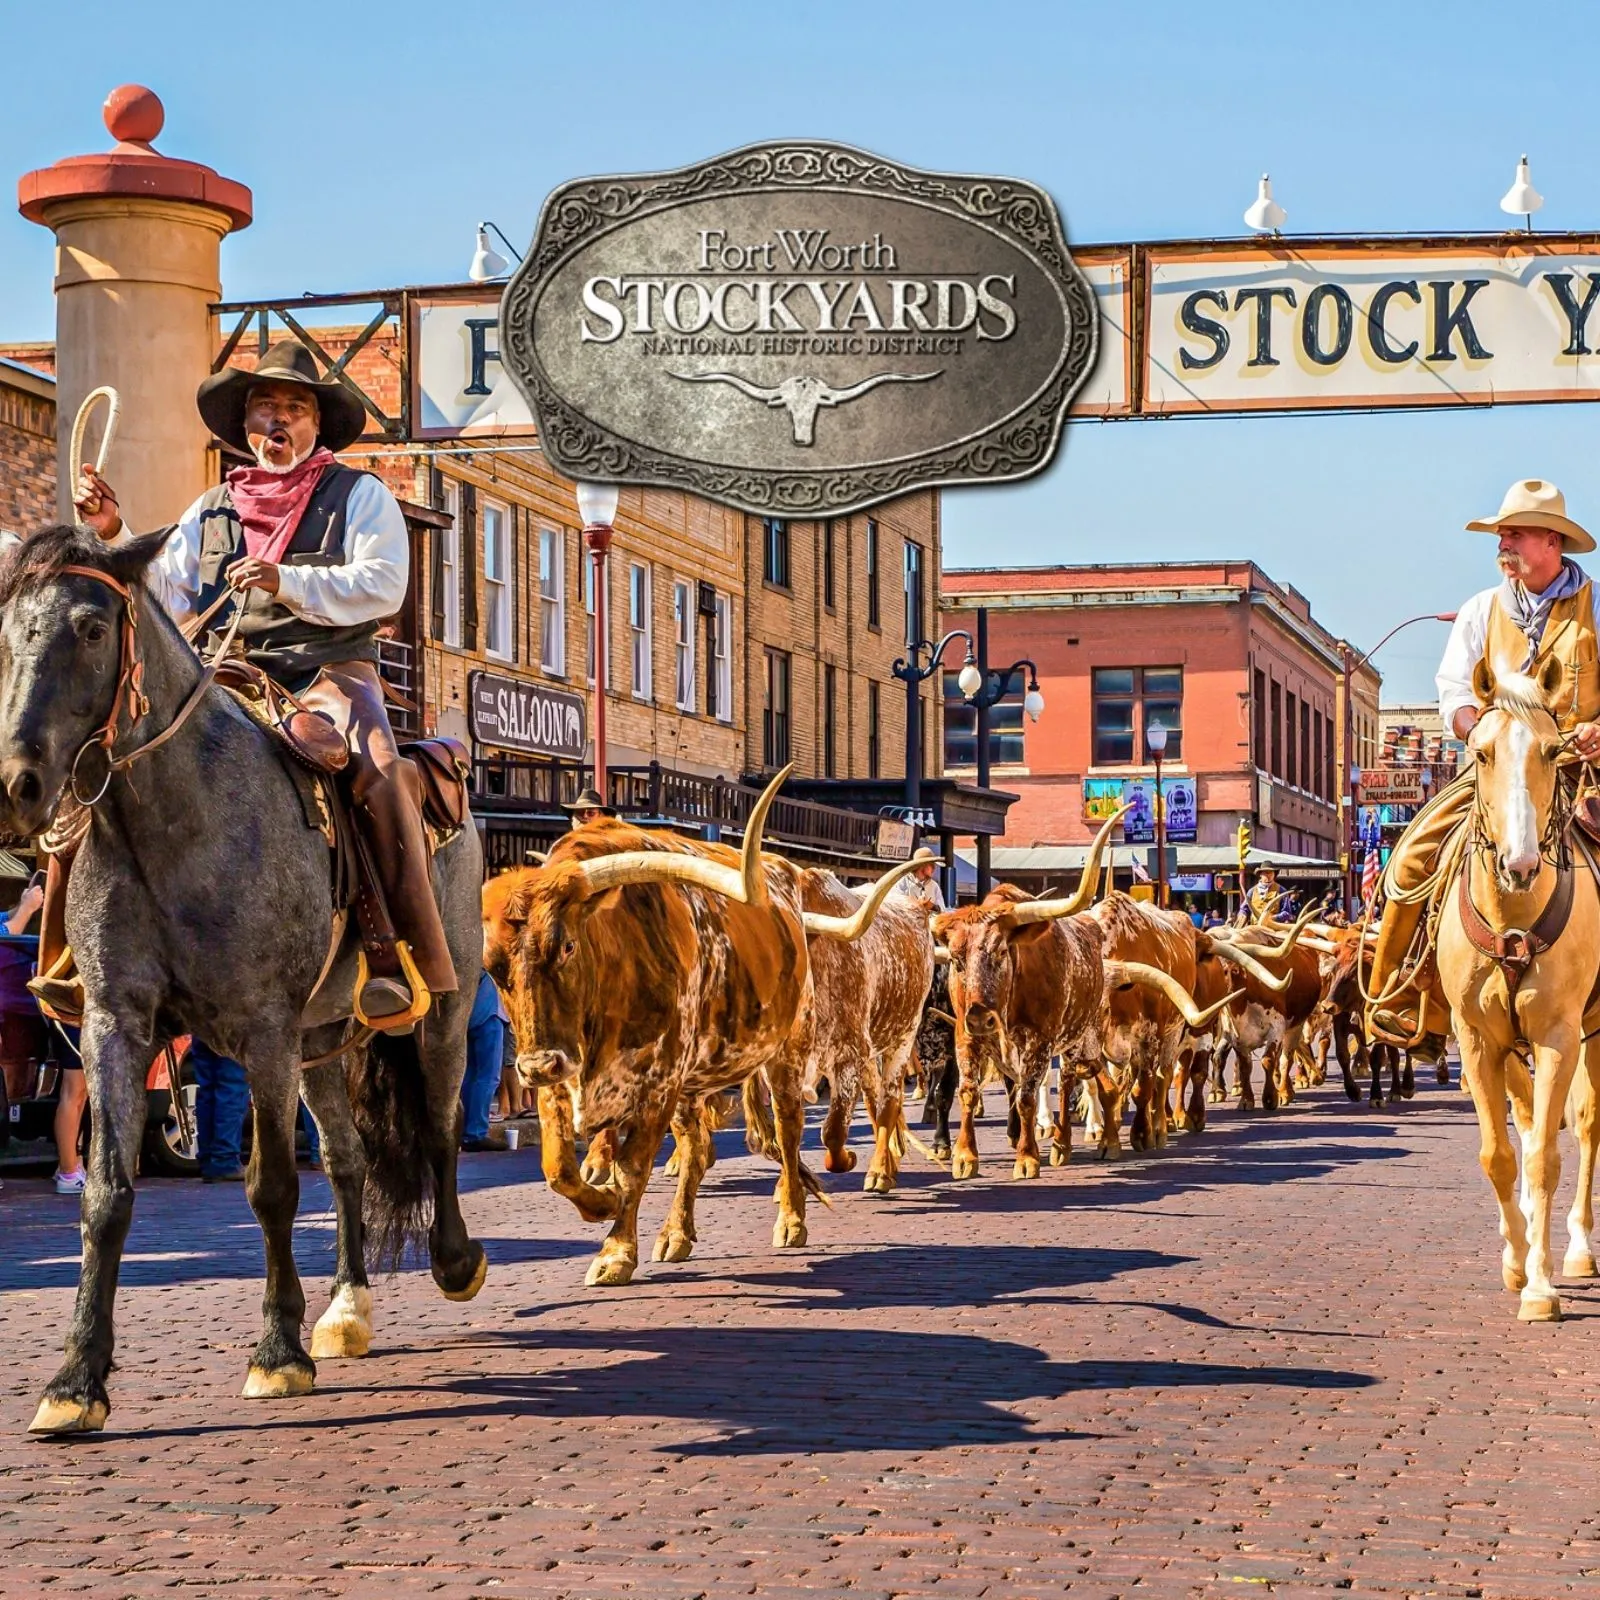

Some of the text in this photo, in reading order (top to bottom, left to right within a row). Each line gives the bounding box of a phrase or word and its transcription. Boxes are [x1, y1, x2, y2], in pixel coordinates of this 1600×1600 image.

[1179, 273, 1600, 370] STOCK Y
[497, 687, 564, 746] SALOON
[1361, 773, 1421, 788] STAR CAFE
